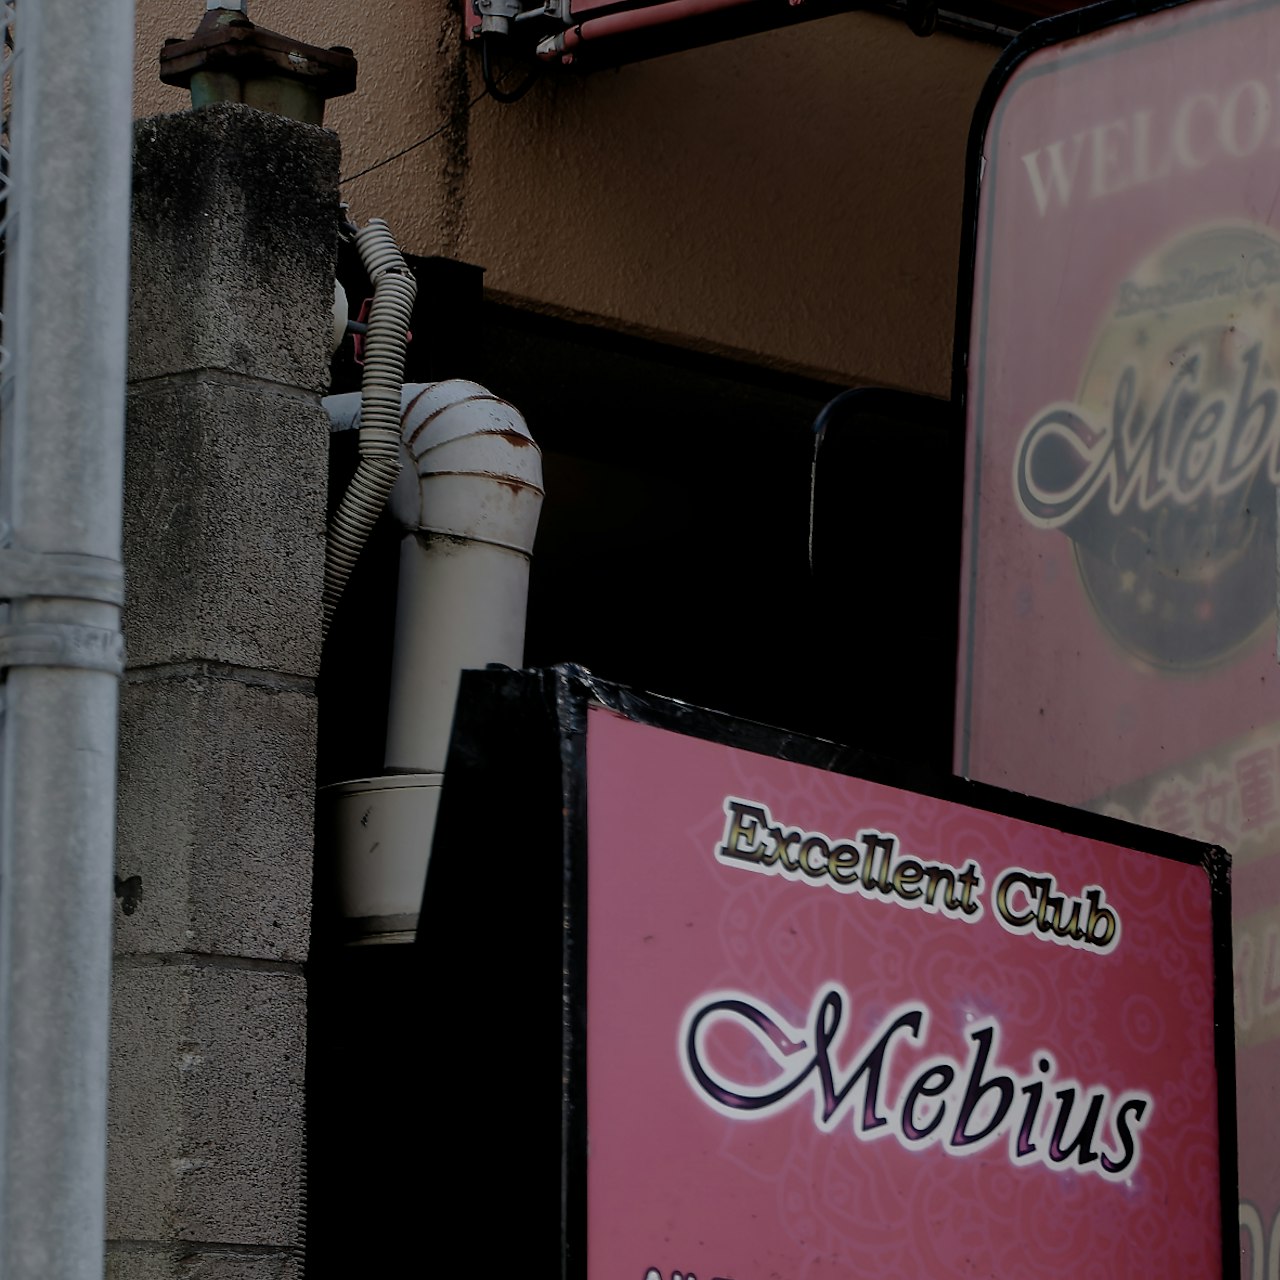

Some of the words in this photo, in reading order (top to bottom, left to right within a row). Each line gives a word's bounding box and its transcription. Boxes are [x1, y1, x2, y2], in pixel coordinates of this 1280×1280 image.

[716, 797, 982, 920] Excellent
[995, 869, 1120, 953] Club
[683, 984, 1150, 1178] Mebius
